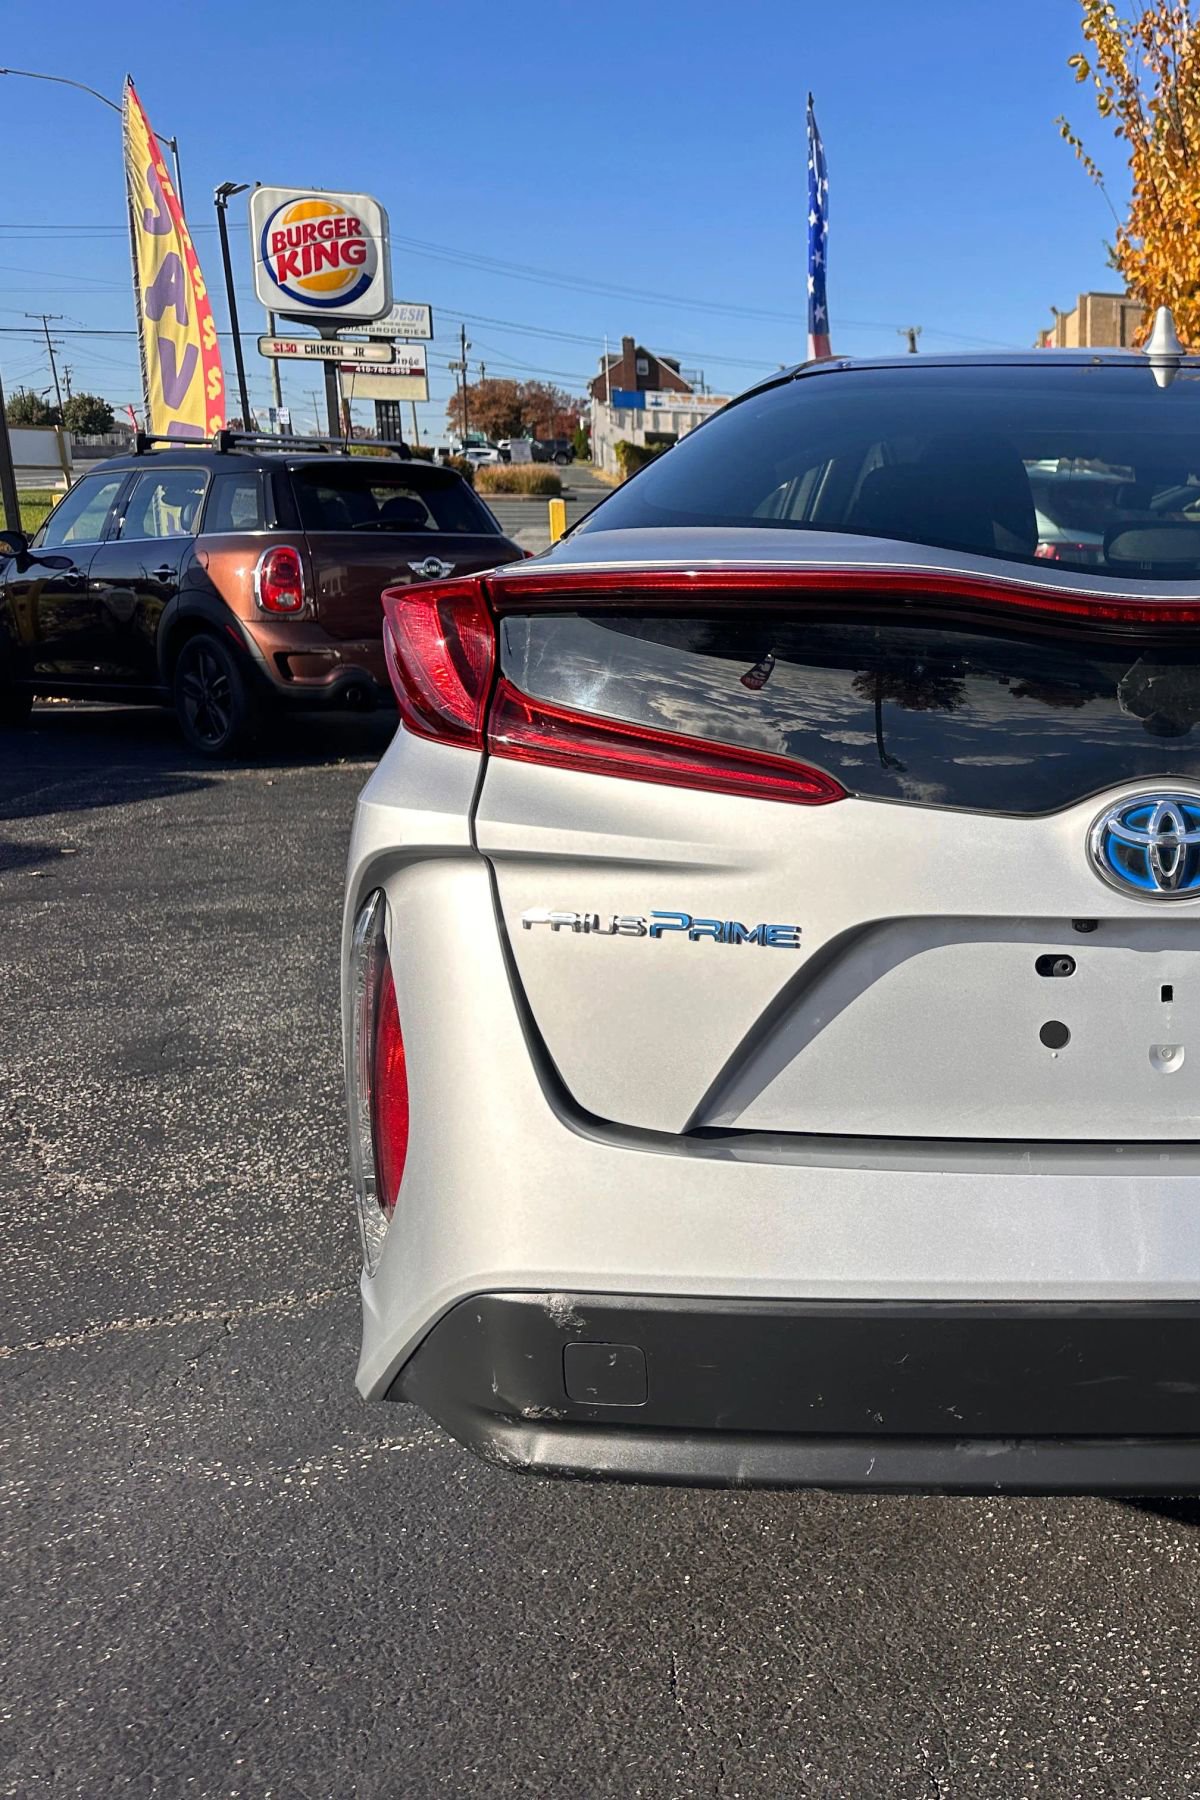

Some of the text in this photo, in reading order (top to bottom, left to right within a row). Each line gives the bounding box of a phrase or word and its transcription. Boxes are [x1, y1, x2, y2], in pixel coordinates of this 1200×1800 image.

[272, 217, 362, 253] BURGER
[276, 239, 367, 283] KING
[304, 344, 344, 356] CHICKEN
[353, 346, 366, 357] JR
[649, 910, 802, 949] PRIME
